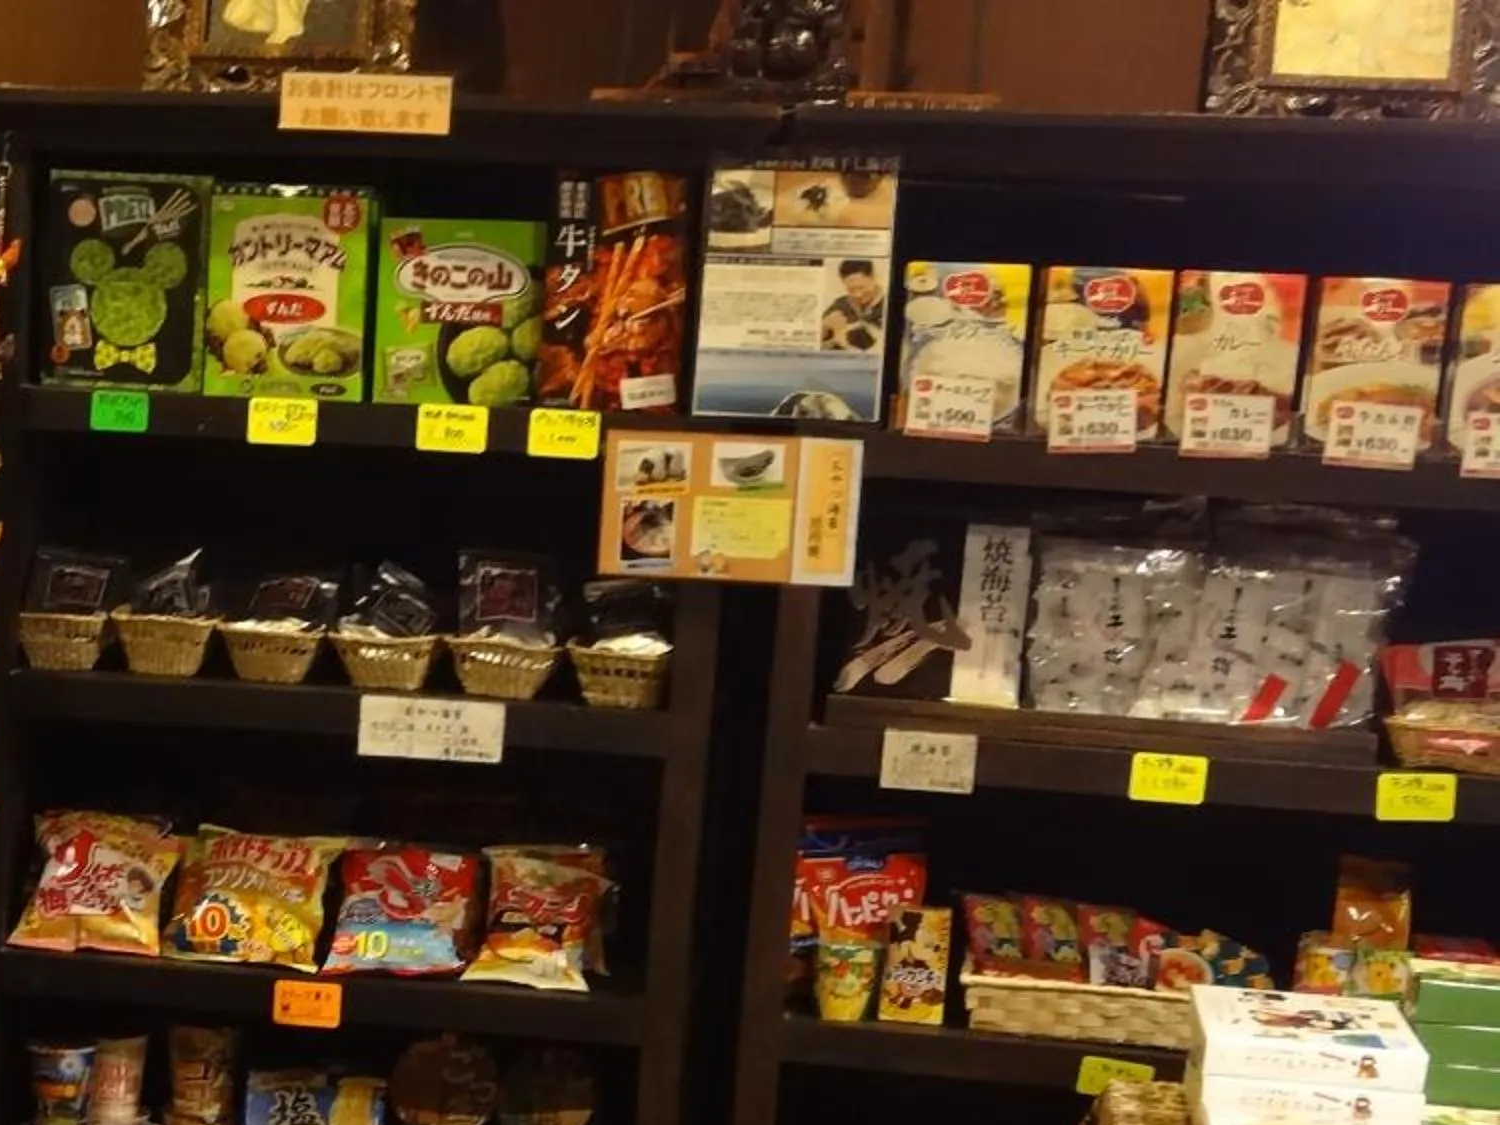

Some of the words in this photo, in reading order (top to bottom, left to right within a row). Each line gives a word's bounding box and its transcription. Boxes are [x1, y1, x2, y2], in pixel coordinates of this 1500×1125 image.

[287, 78, 449, 102] お会計はフロントで
[301, 105, 431, 129] お願い致します
[227, 232, 347, 272] カントリーマアム
[411, 260, 513, 290] きのこの山
[554, 222, 587, 331] 牛タン
[980, 535, 1013, 623] 焼海苔
